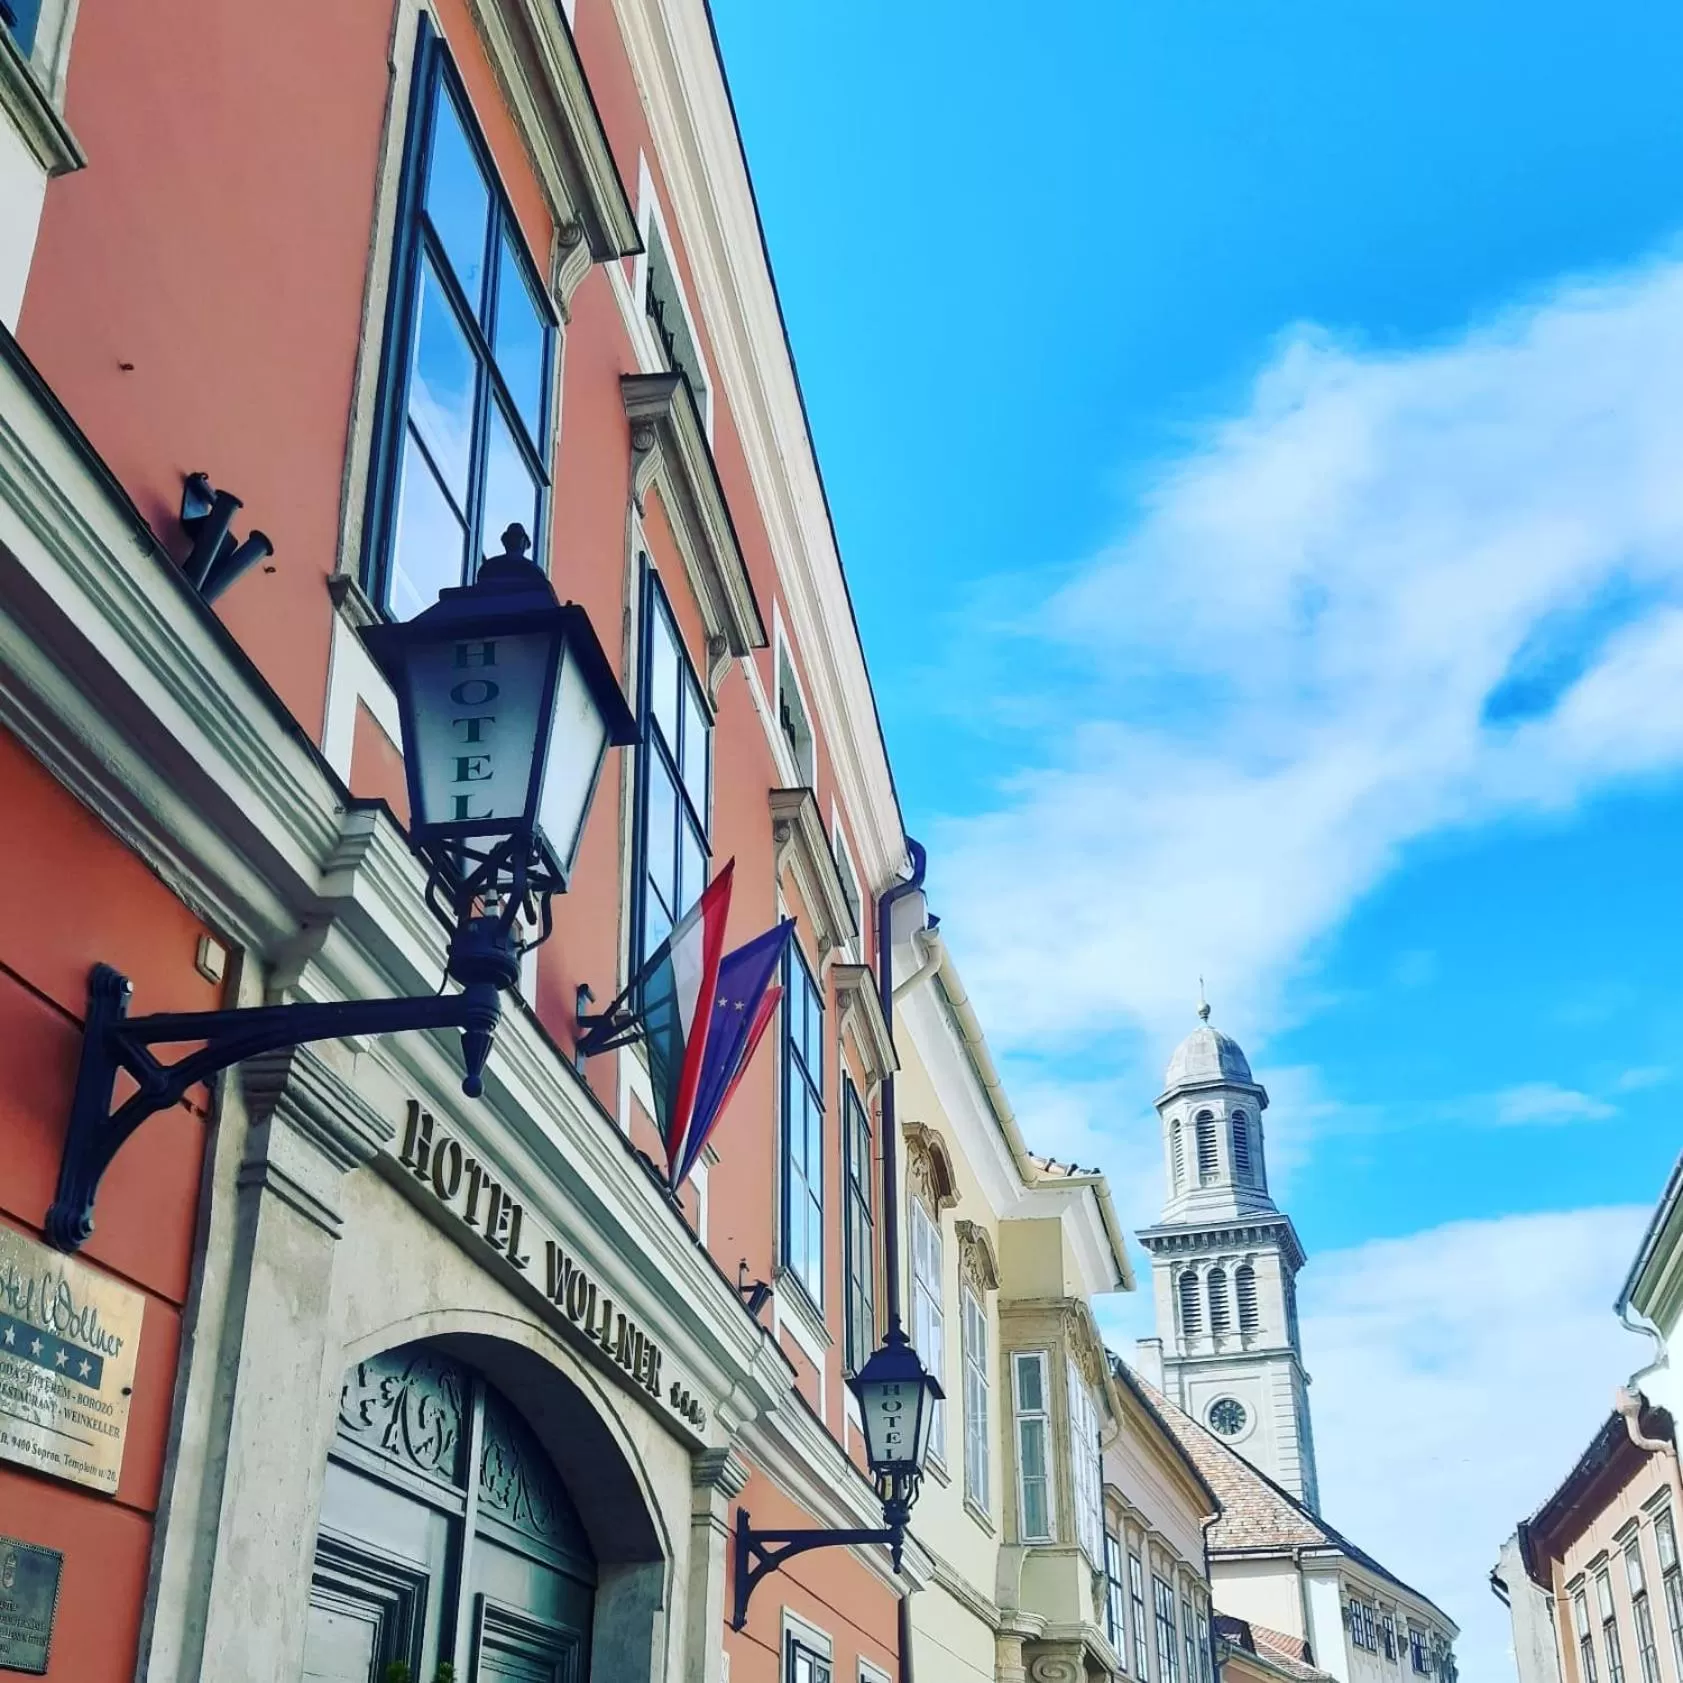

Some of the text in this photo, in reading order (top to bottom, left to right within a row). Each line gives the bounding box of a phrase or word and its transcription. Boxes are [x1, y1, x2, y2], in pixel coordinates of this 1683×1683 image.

[450, 641, 499, 820] HOTEL
[398, 1099, 531, 1269] HOTEL
[545, 1240, 662, 1397] WOLLNER
[63, 1406, 120, 1440] WEINKELLER
[881, 1384, 903, 1460] HOTEL
